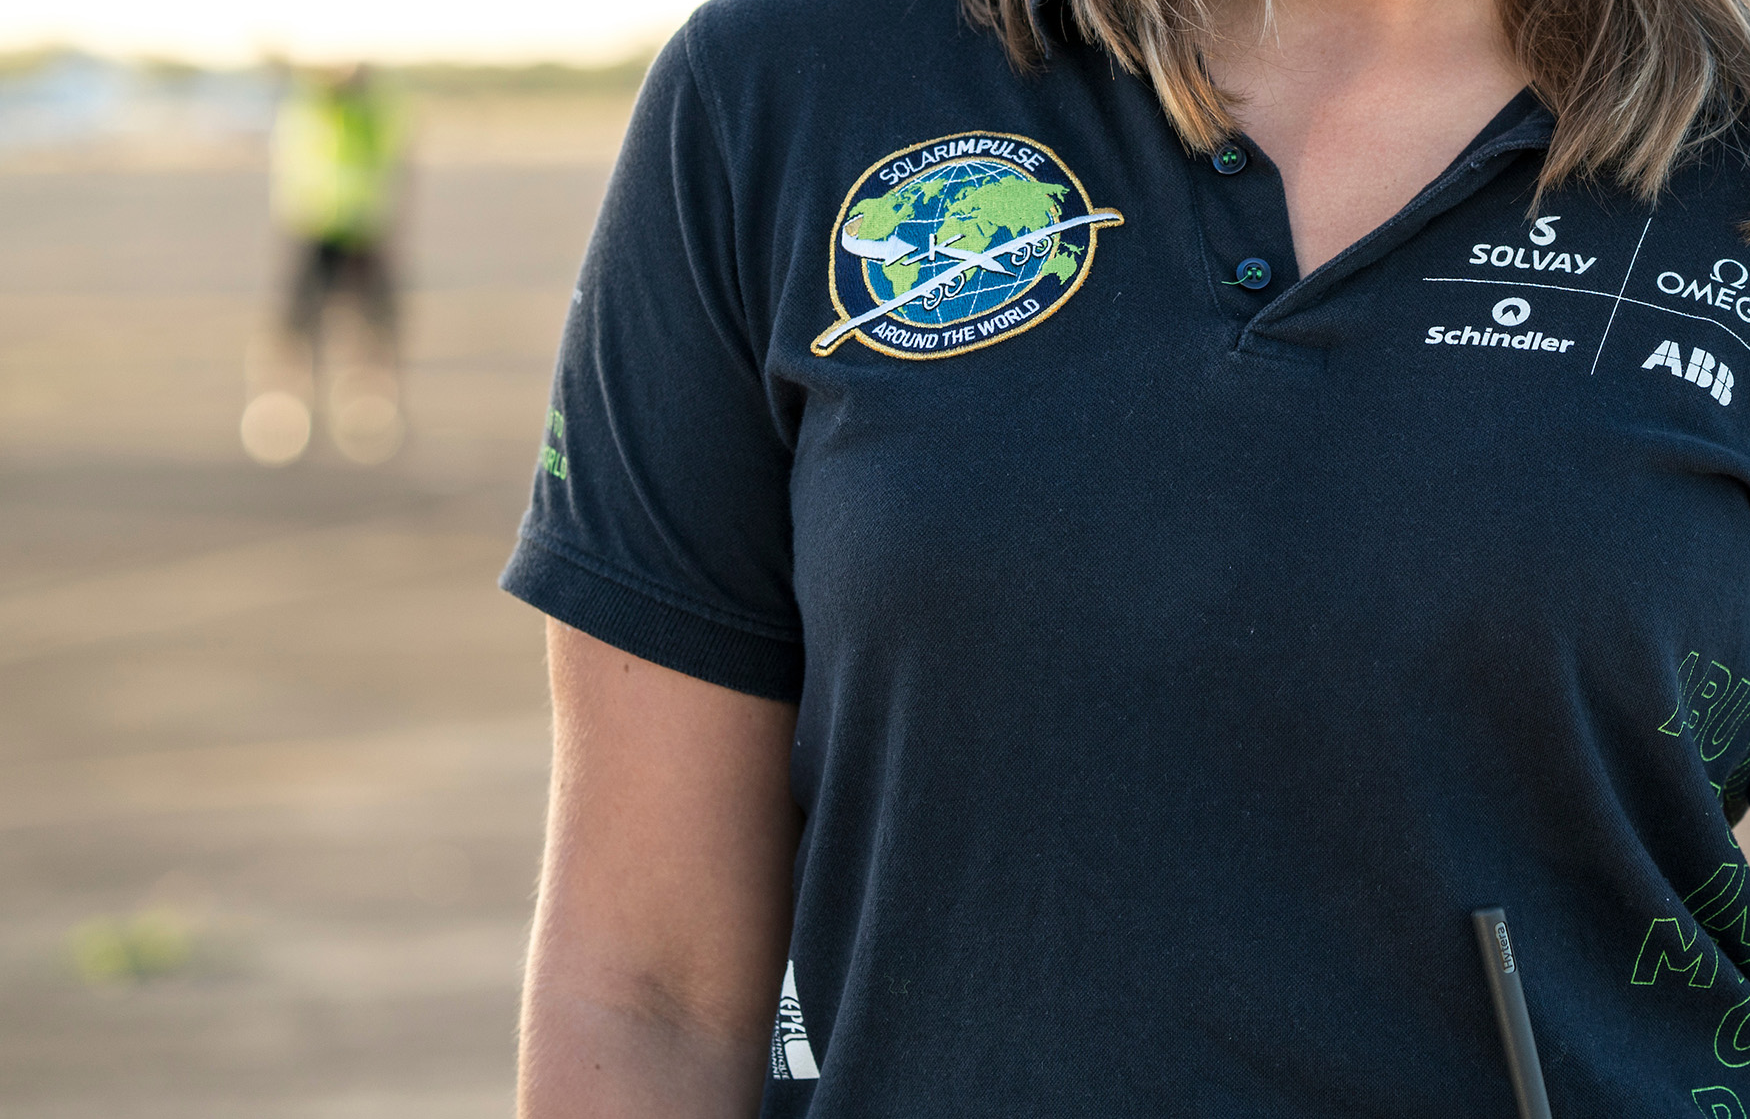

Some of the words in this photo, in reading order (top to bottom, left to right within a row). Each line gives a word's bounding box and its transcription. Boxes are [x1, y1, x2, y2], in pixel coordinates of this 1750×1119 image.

[1469, 243, 1597, 275] SOLVAY
[871, 320, 939, 350] AROUND
[941, 324, 976, 348] THE
[977, 298, 1041, 337] WORLD
[1425, 325, 1575, 354] Schindler
[1641, 339, 1735, 407] ABB
[1498, 926, 1514, 971] Hytera
